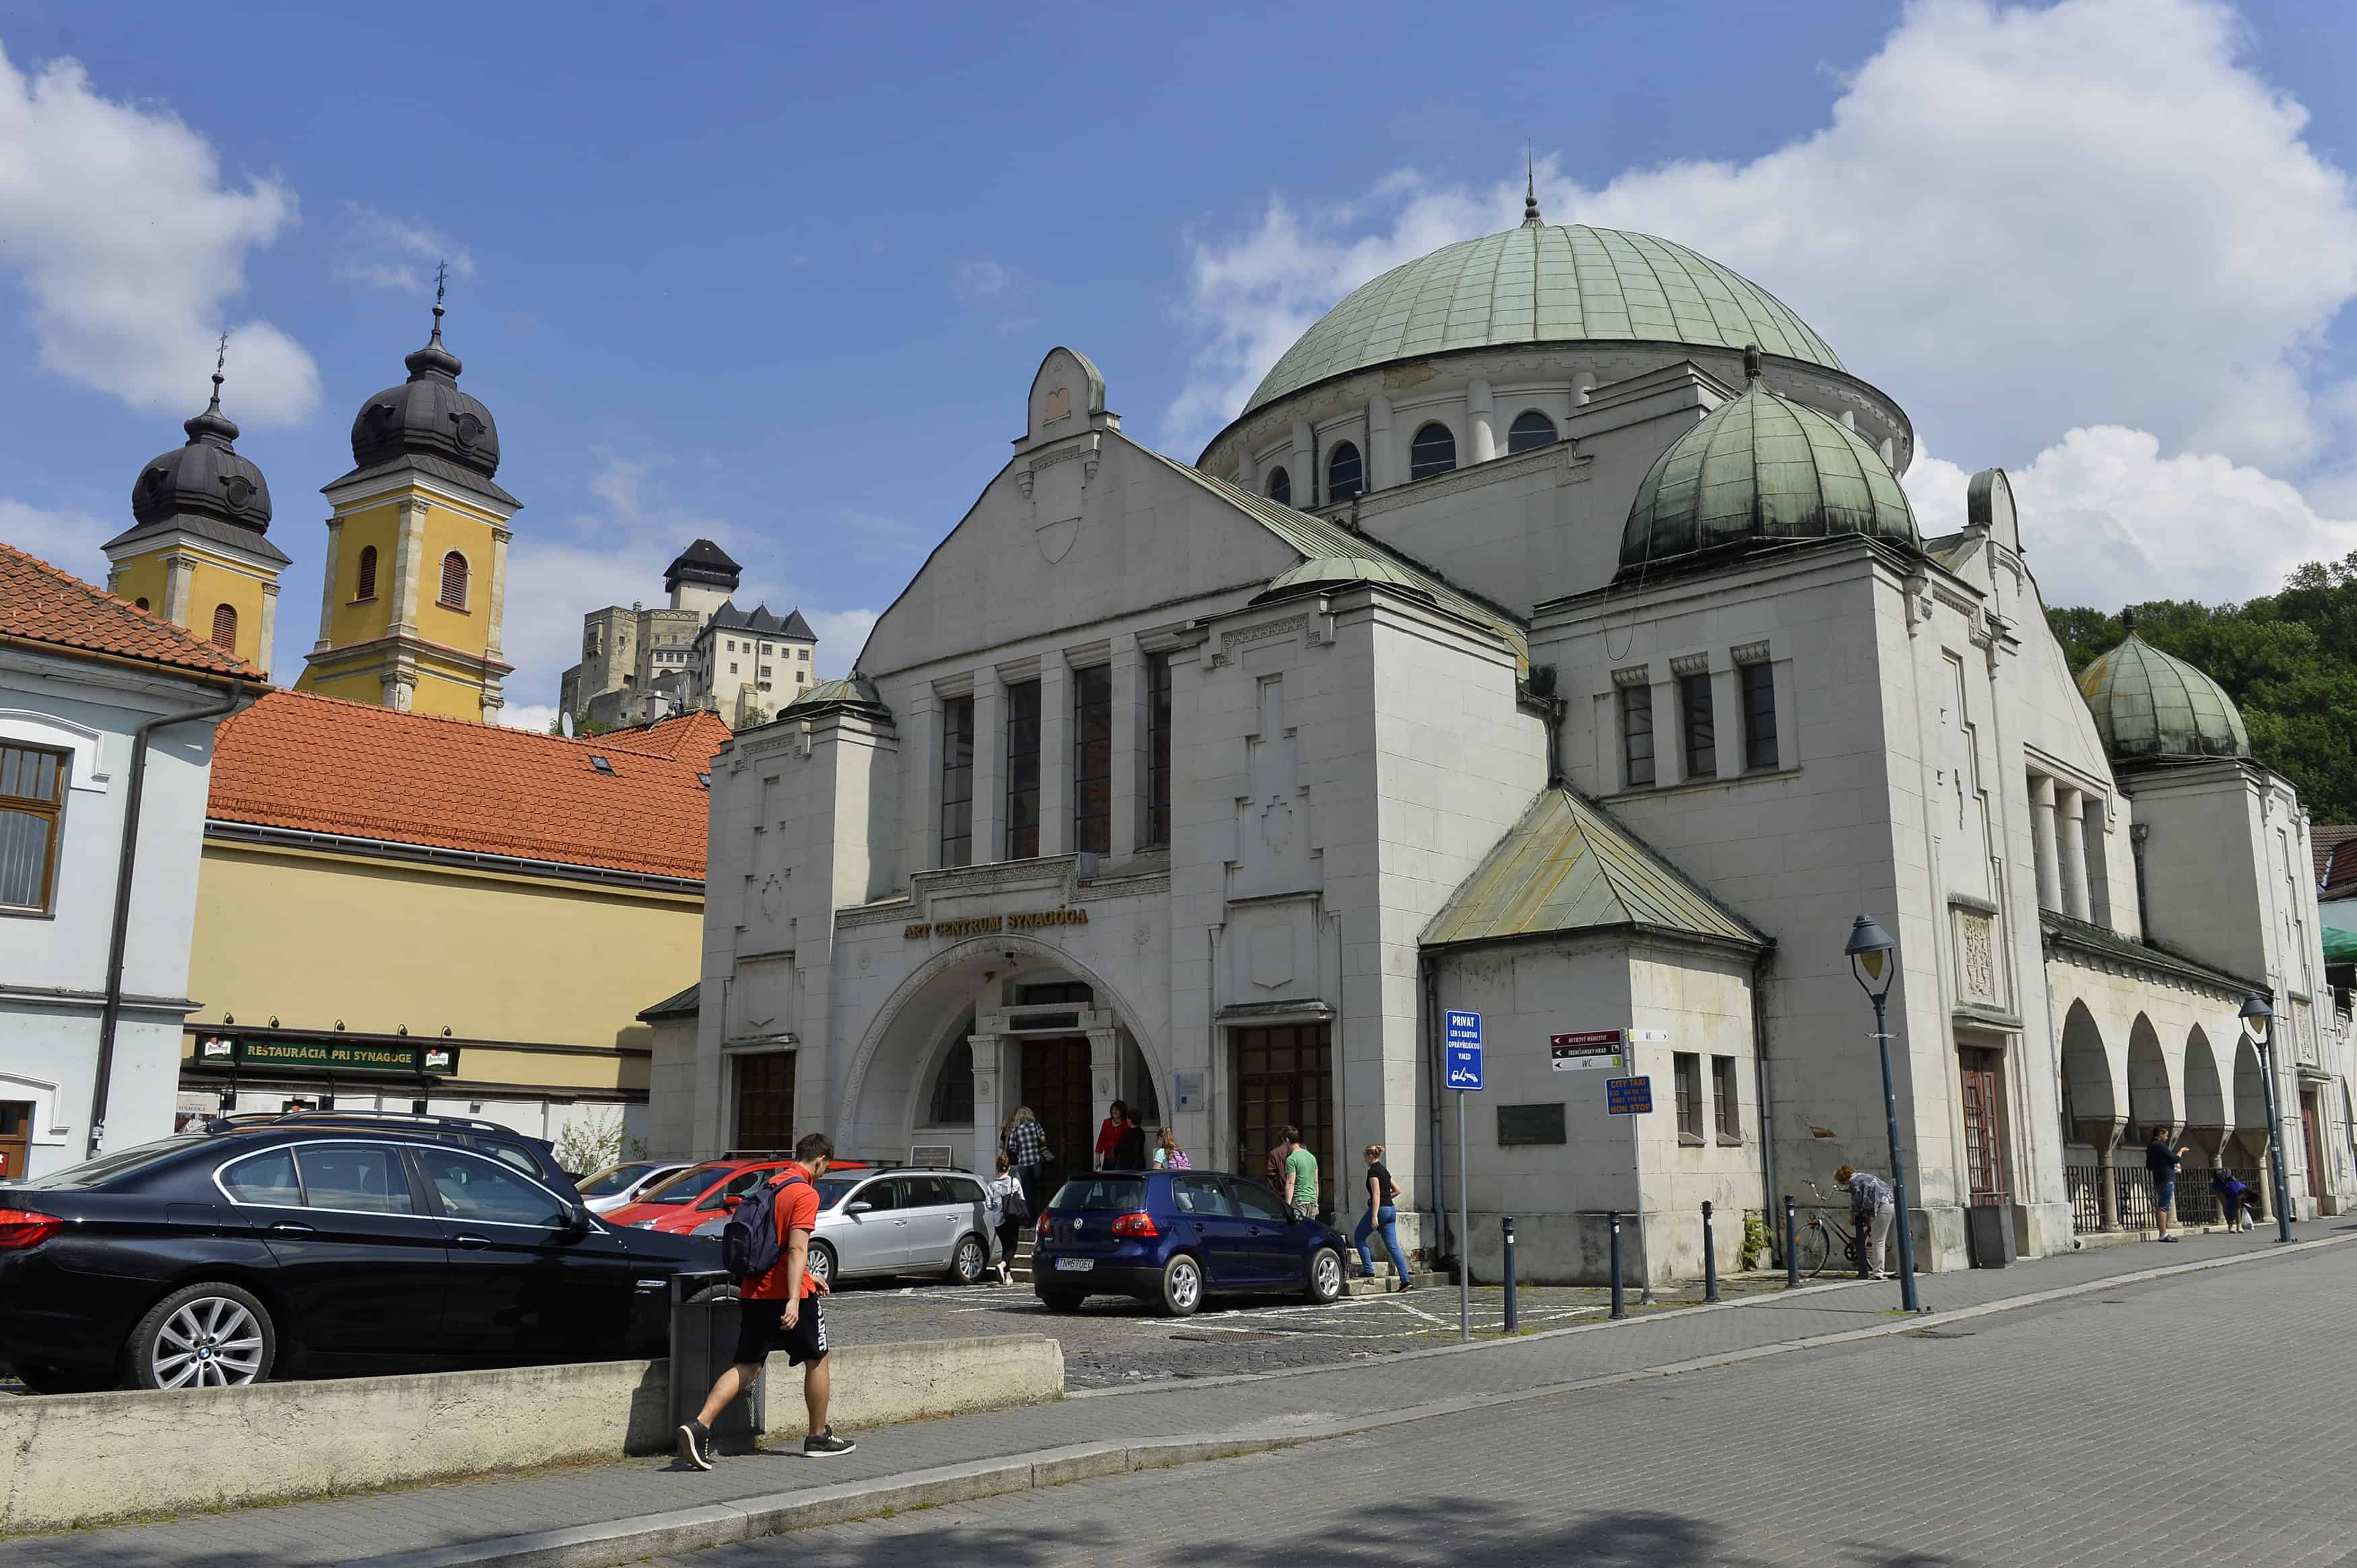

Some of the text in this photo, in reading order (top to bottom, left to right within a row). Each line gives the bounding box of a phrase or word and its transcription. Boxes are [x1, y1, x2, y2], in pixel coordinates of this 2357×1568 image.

[903, 923, 930, 938] ART
[934, 916, 1002, 937] CENTRUM
[1452, 1015, 1474, 1027] PRIVAT
[331, 1050, 350, 1060] PRI
[354, 1051, 411, 1063] SYNAGOGE
[1582, 1058, 1592, 1067] WC
[1611, 1078, 1646, 1089] CITY TAXI
